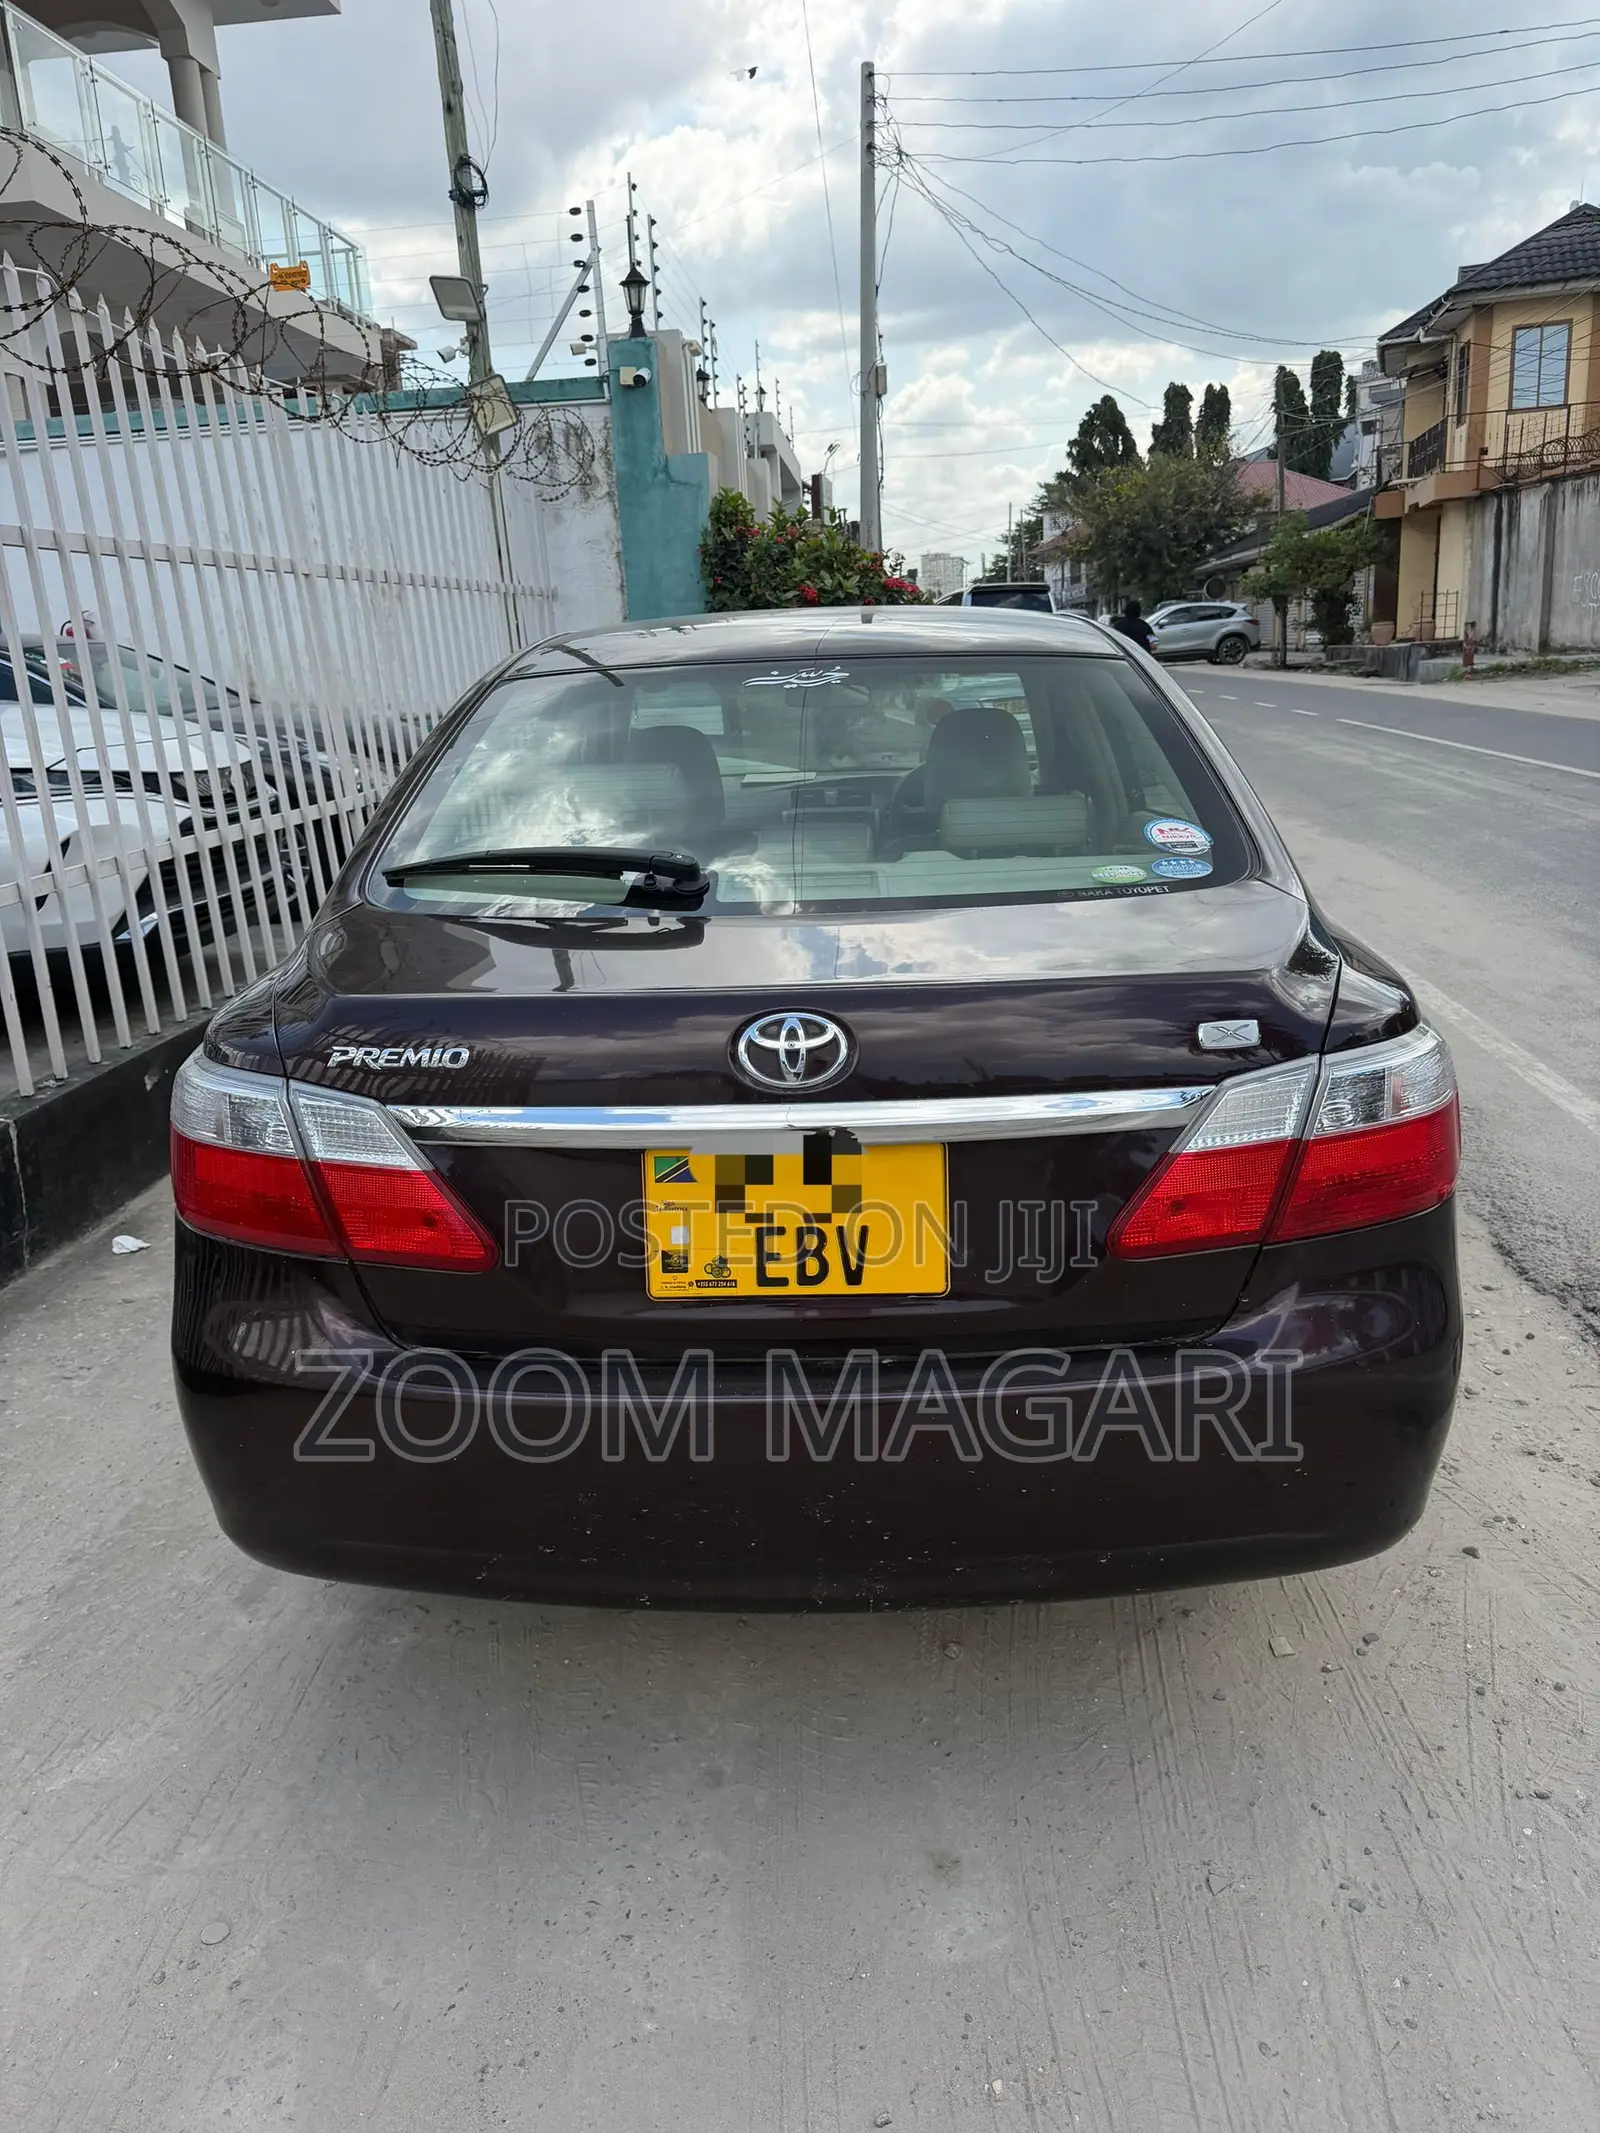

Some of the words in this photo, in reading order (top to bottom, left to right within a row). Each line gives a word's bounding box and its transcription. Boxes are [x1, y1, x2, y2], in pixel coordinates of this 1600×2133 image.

[1115, 885, 1170, 896] TOYOPET
[327, 1046, 470, 1070] PREMIO
[755, 1225, 869, 1287] EBV
